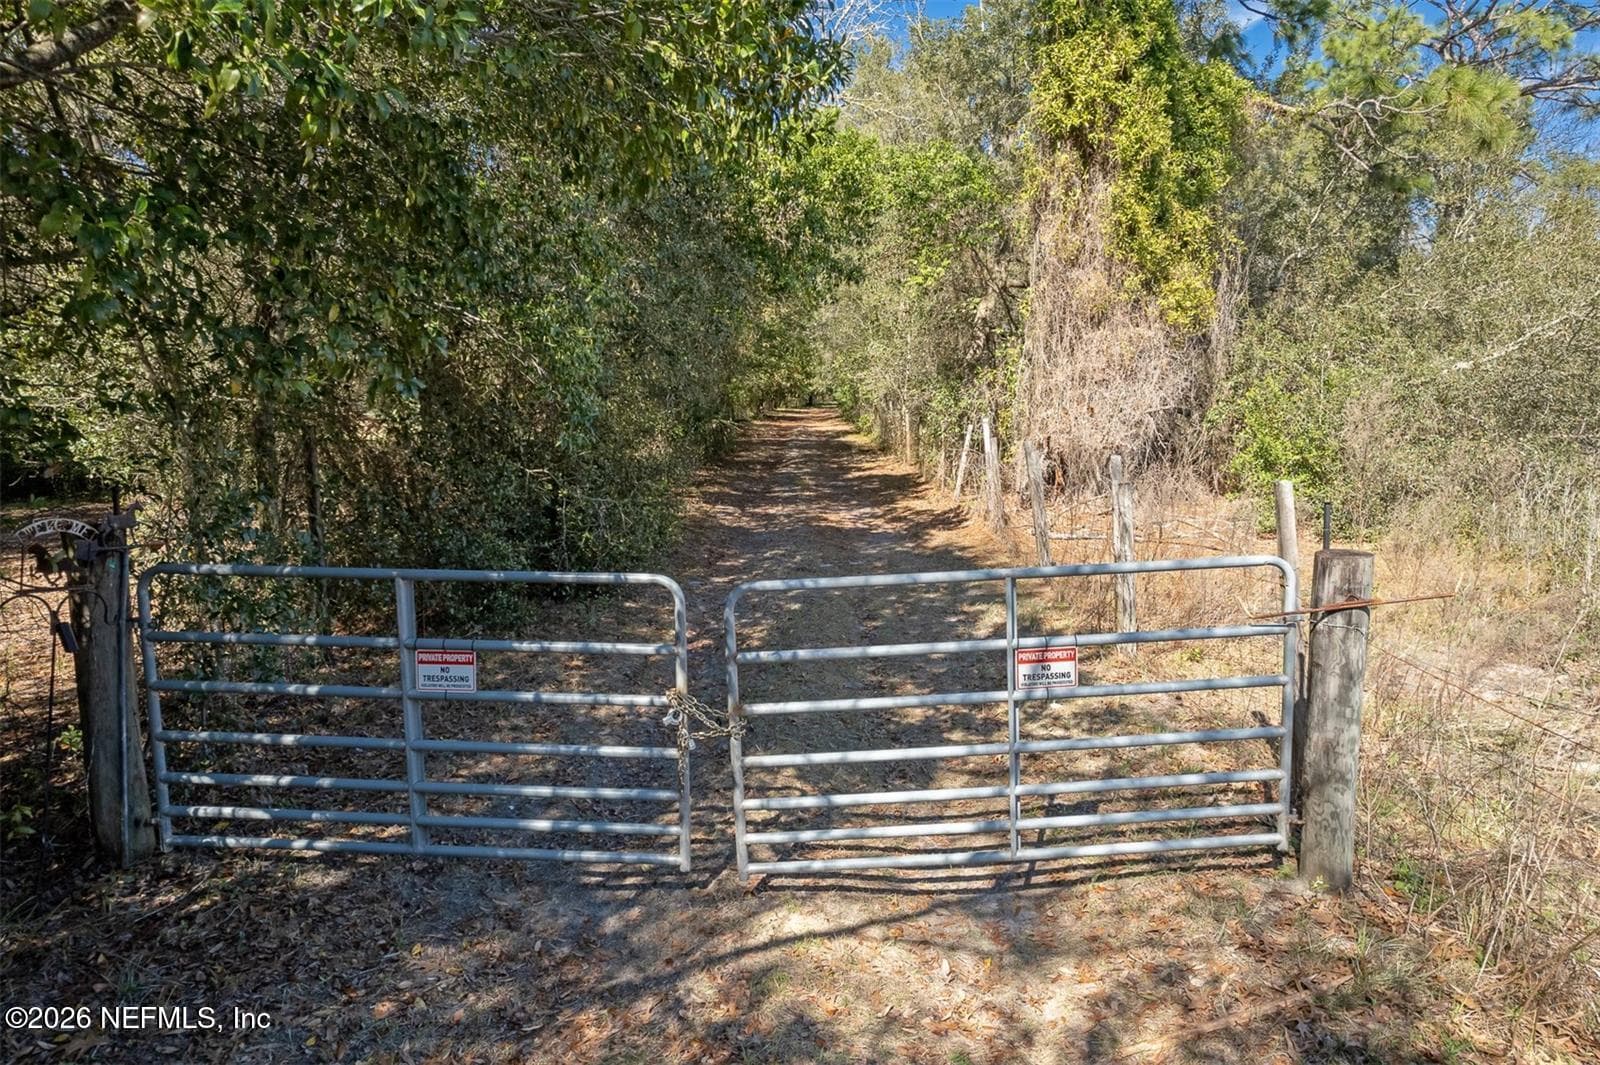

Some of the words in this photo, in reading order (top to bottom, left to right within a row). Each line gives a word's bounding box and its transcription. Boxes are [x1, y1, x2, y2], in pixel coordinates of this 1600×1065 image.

[418, 653, 443, 662] PRIVATE
[443, 653, 474, 663] PROPERTY
[1018, 651, 1043, 661] PRIVATE
[1043, 650, 1075, 660] PROPERTY
[440, 666, 450, 674] NO
[1040, 664, 1052, 672] NO
[423, 674, 470, 683] TRESPASSING
[1022, 672, 1072, 681] TRESPASSING
